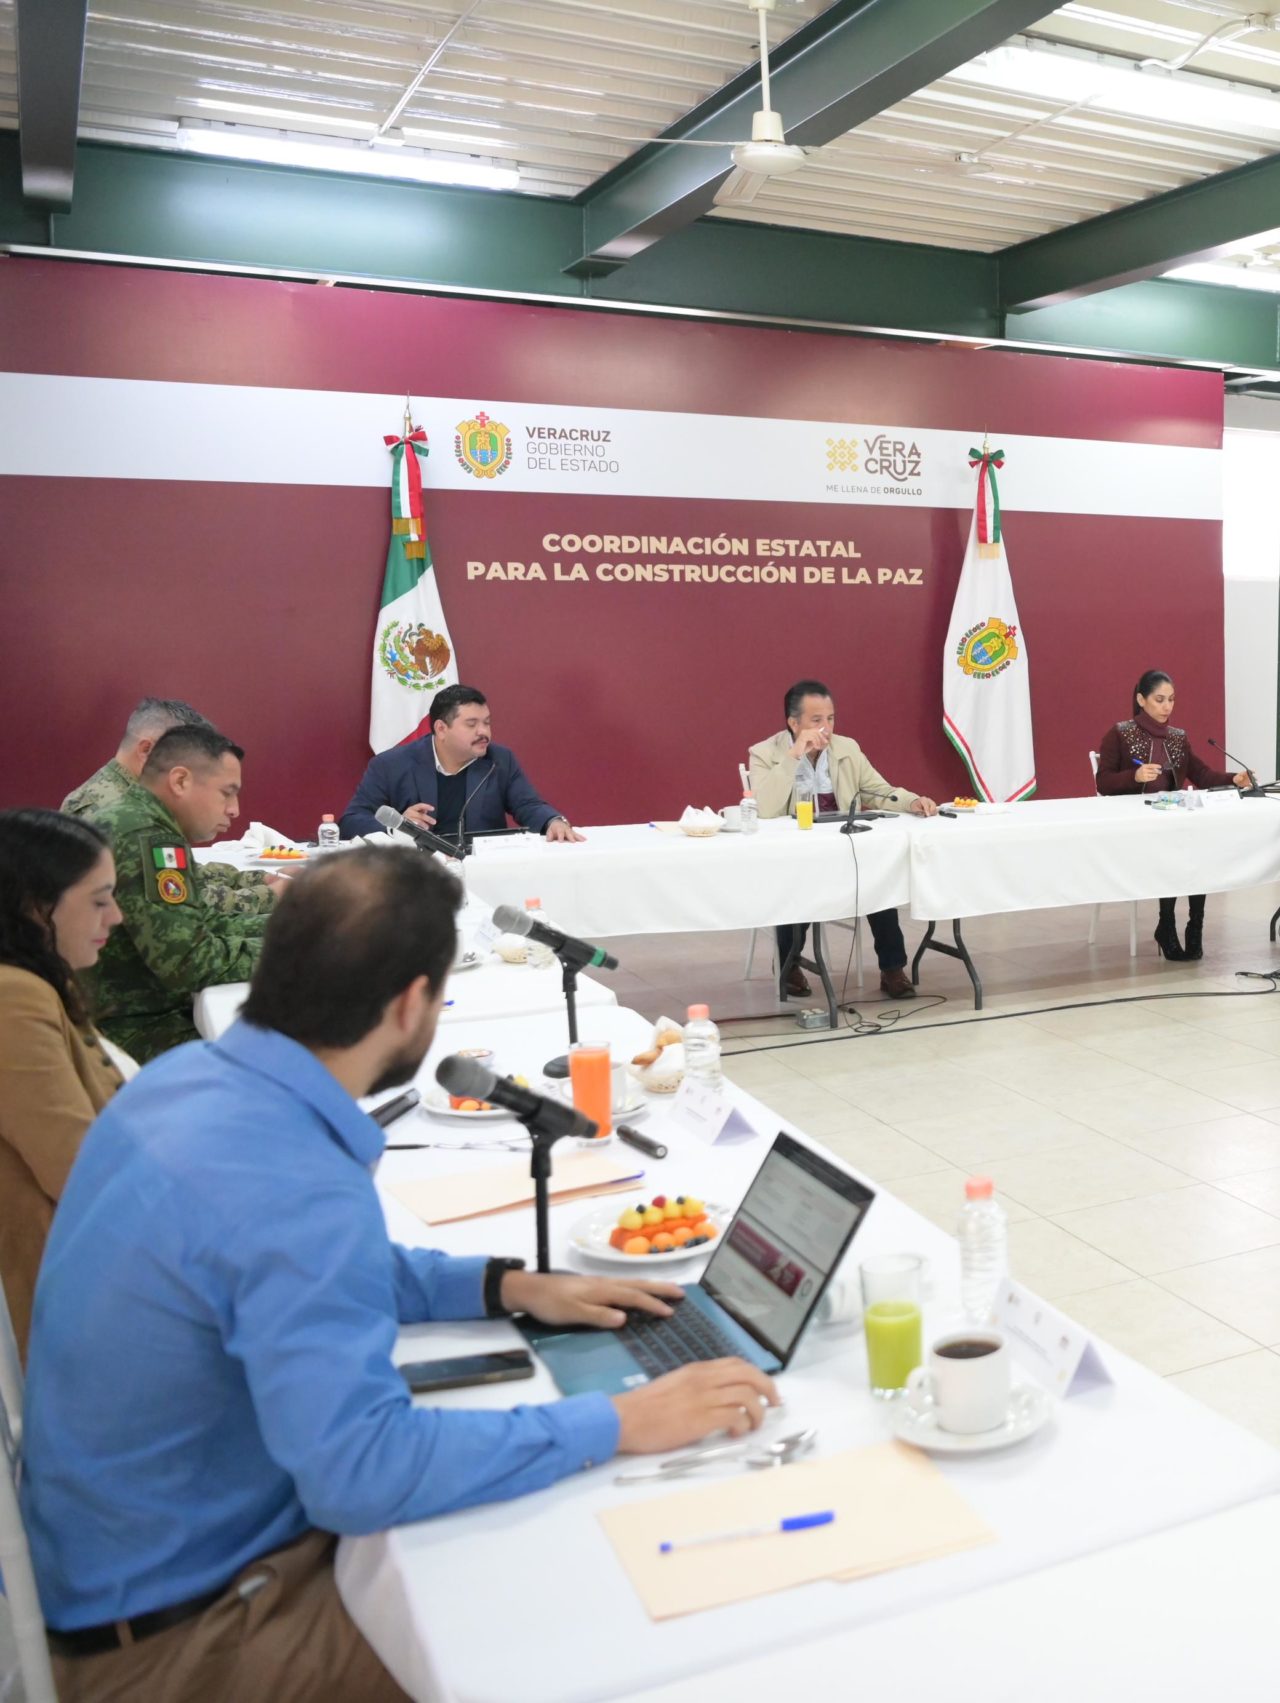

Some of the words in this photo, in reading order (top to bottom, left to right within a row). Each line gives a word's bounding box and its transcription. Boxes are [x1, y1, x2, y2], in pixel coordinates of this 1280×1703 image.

[526, 426, 611, 442] VERACRUZ
[526, 441, 606, 458] GOBIERNO
[864, 434, 921, 459] VERA
[527, 457, 557, 471] DEL
[560, 458, 620, 473] ESTADO
[864, 458, 921, 482] CRUZ
[826, 485, 839, 493] ME
[841, 485, 869, 494] LLENA
[870, 486, 881, 494] DE
[883, 486, 922, 496] ORGULLO
[542, 533, 749, 556] COORDINACIÓN
[756, 538, 862, 558] ESTATAL
[466, 561, 547, 581] PARA
[553, 562, 590, 582] LA
[595, 561, 796, 584] CONSTRUCCIÓN
[803, 566, 835, 584] DE
[842, 567, 872, 585] LA
[877, 568, 924, 585] PAZ
